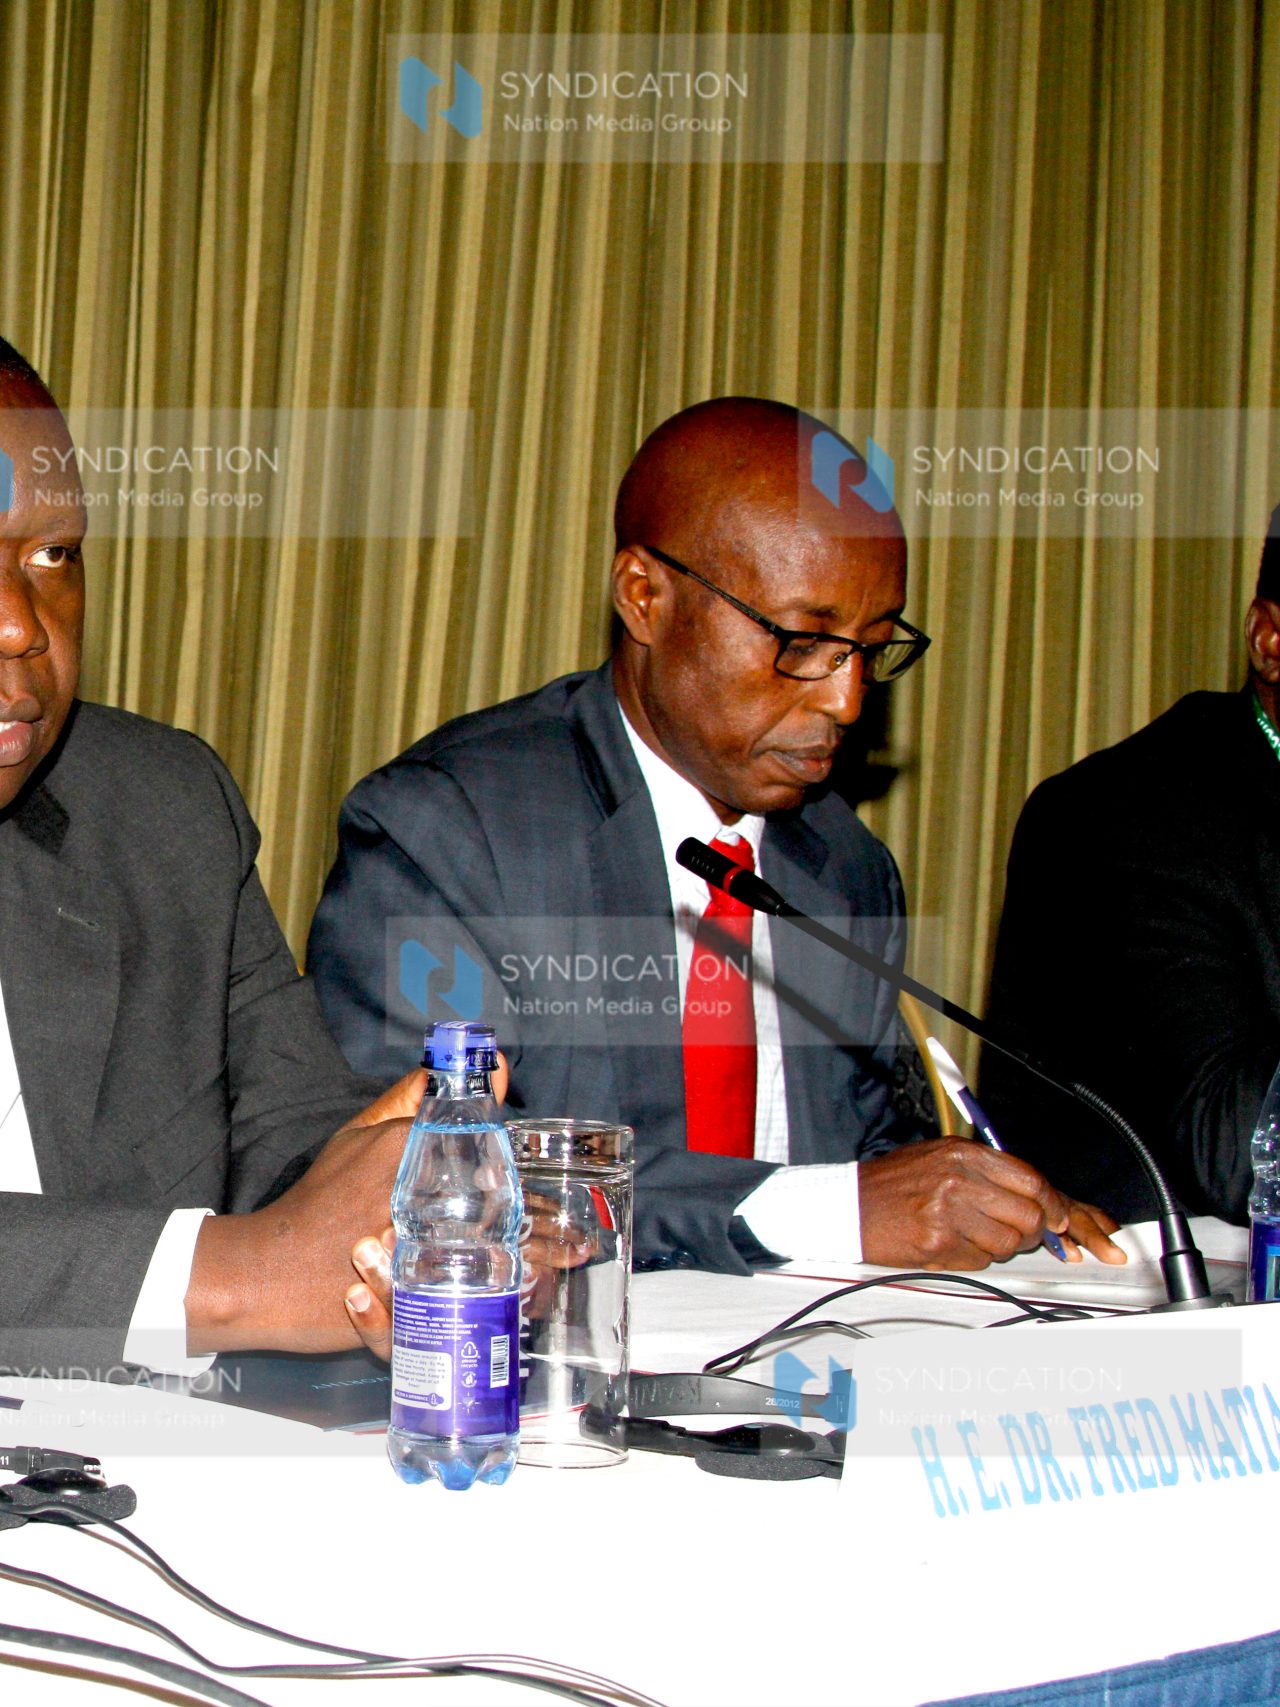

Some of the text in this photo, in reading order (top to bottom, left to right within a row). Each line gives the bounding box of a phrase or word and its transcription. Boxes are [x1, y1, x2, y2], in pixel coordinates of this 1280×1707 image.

[912, 1425, 969, 1518] H.
[956, 1420, 1011, 1511] E.
[997, 1411, 1081, 1505] DR.
[1066, 1397, 1180, 1497] FRED
